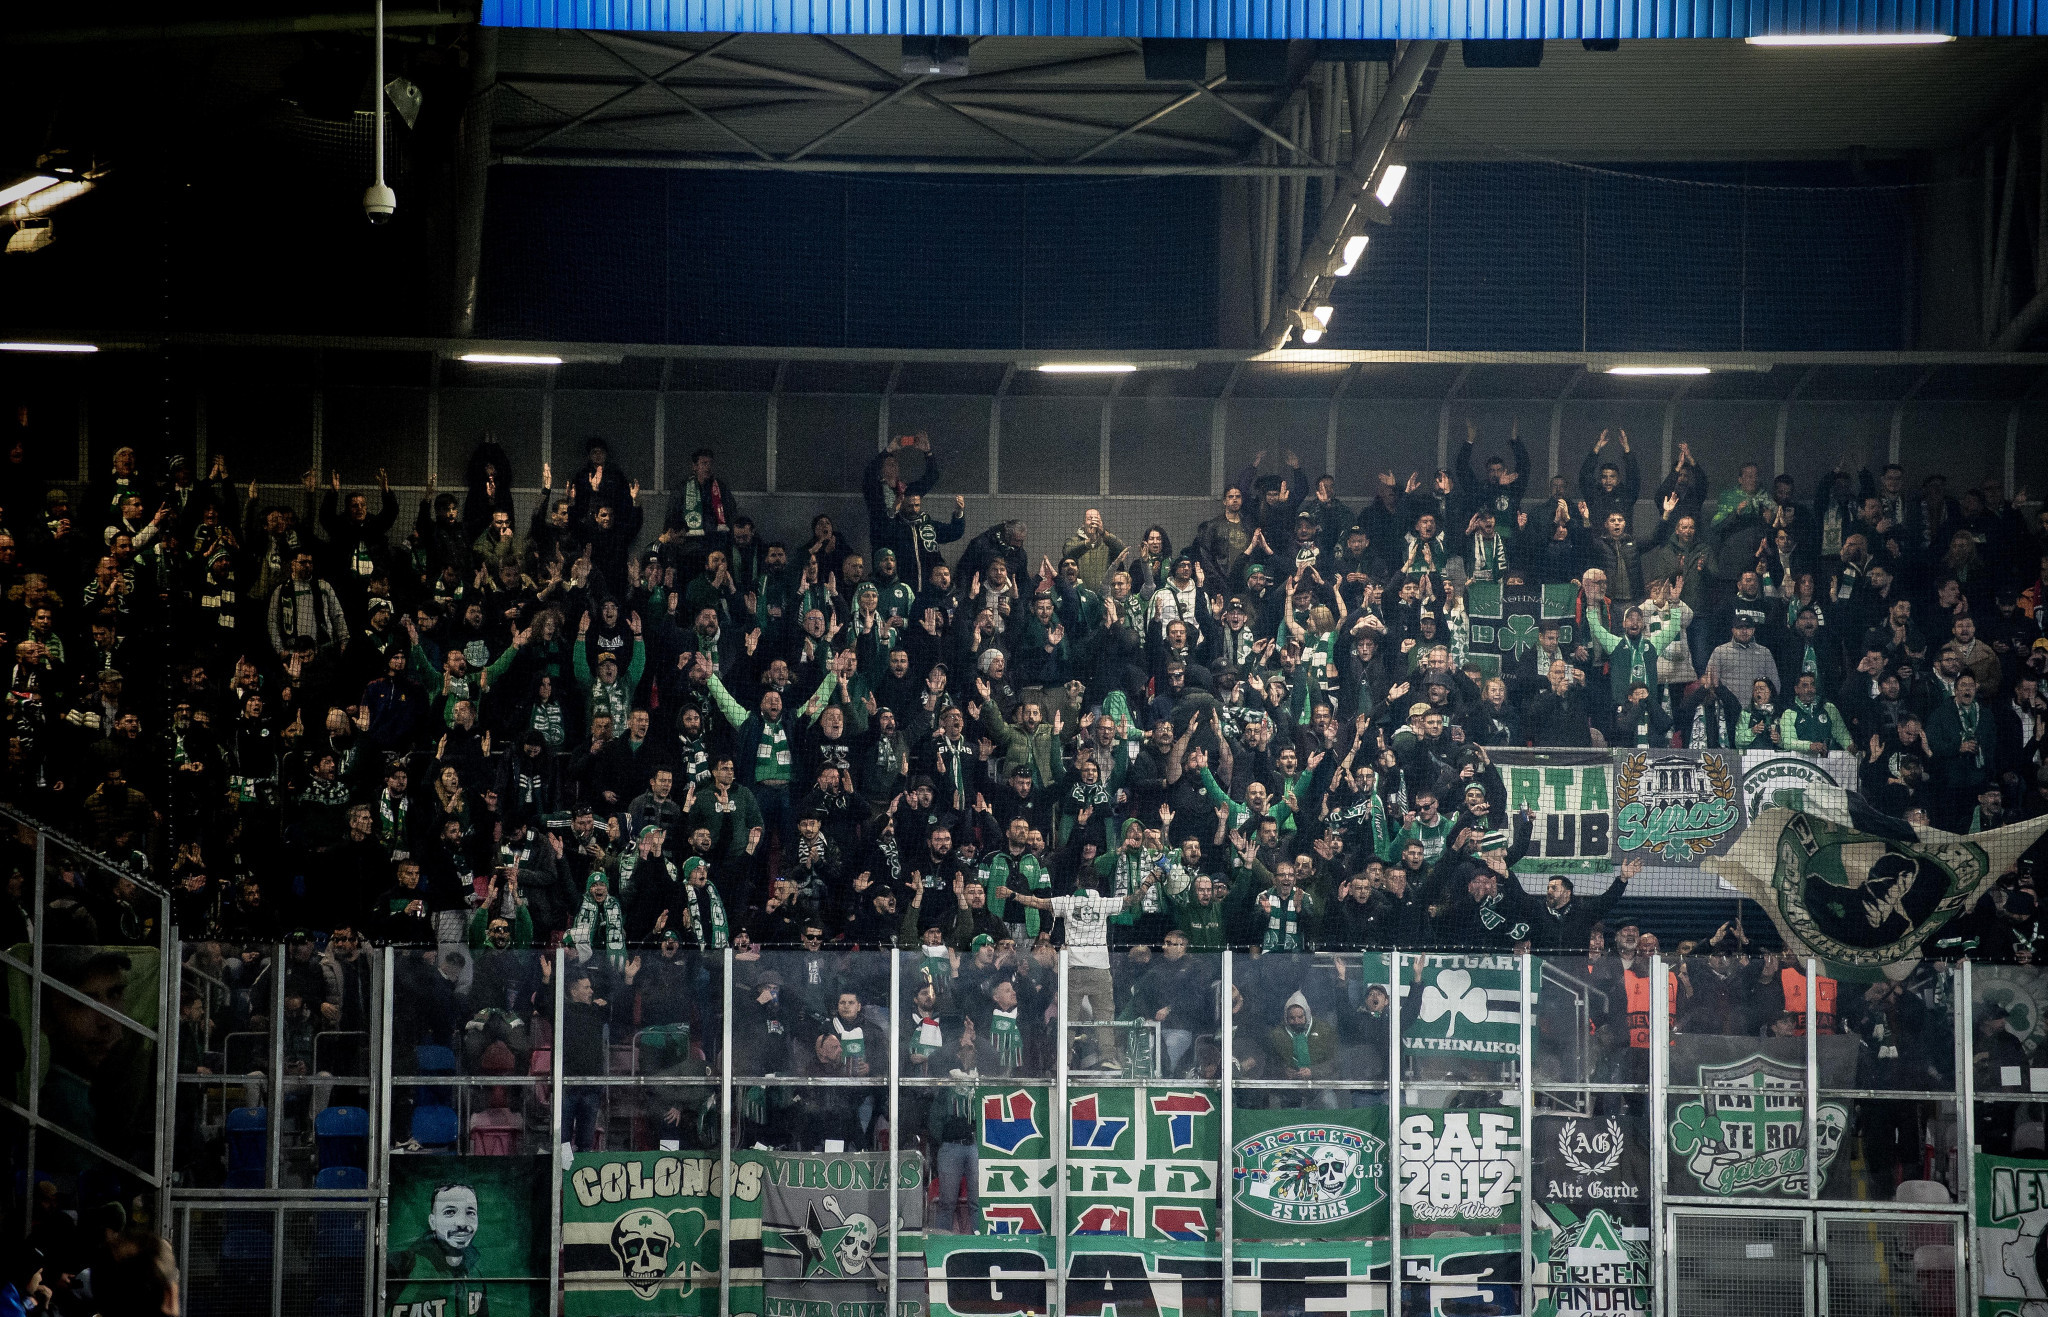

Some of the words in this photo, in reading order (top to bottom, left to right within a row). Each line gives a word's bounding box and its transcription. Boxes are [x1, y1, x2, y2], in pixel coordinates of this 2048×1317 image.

[1499, 812, 1610, 857] LUB
[1617, 797, 1740, 851] Syros
[1242, 1129, 1376, 1157] BROTHERS
[1400, 1112, 1514, 1161] SAF
[1573, 1132, 1611, 1154] AG
[571, 1156, 765, 1208] COLONOS
[764, 1157, 922, 1191] VIRONAS
[985, 1164, 1213, 1193] RAPID
[1352, 1163, 1384, 1179] G.13
[1718, 1156, 1777, 1194] gate
[1778, 1149, 1805, 1174] 13
[1546, 1180, 1583, 1199] Alte
[1587, 1180, 1639, 1199] Garde
[1271, 1202, 1294, 1220] 25
[1299, 1199, 1350, 1221] YEARS
[1412, 1201, 1458, 1221] Rapid
[1457, 1200, 1503, 1220] Wien
[942, 1248, 1350, 1317] GATE
[1548, 1260, 1650, 1284] GREEN
[765, 1296, 834, 1317] NEVER
[836, 1300, 889, 1317] GIVE
